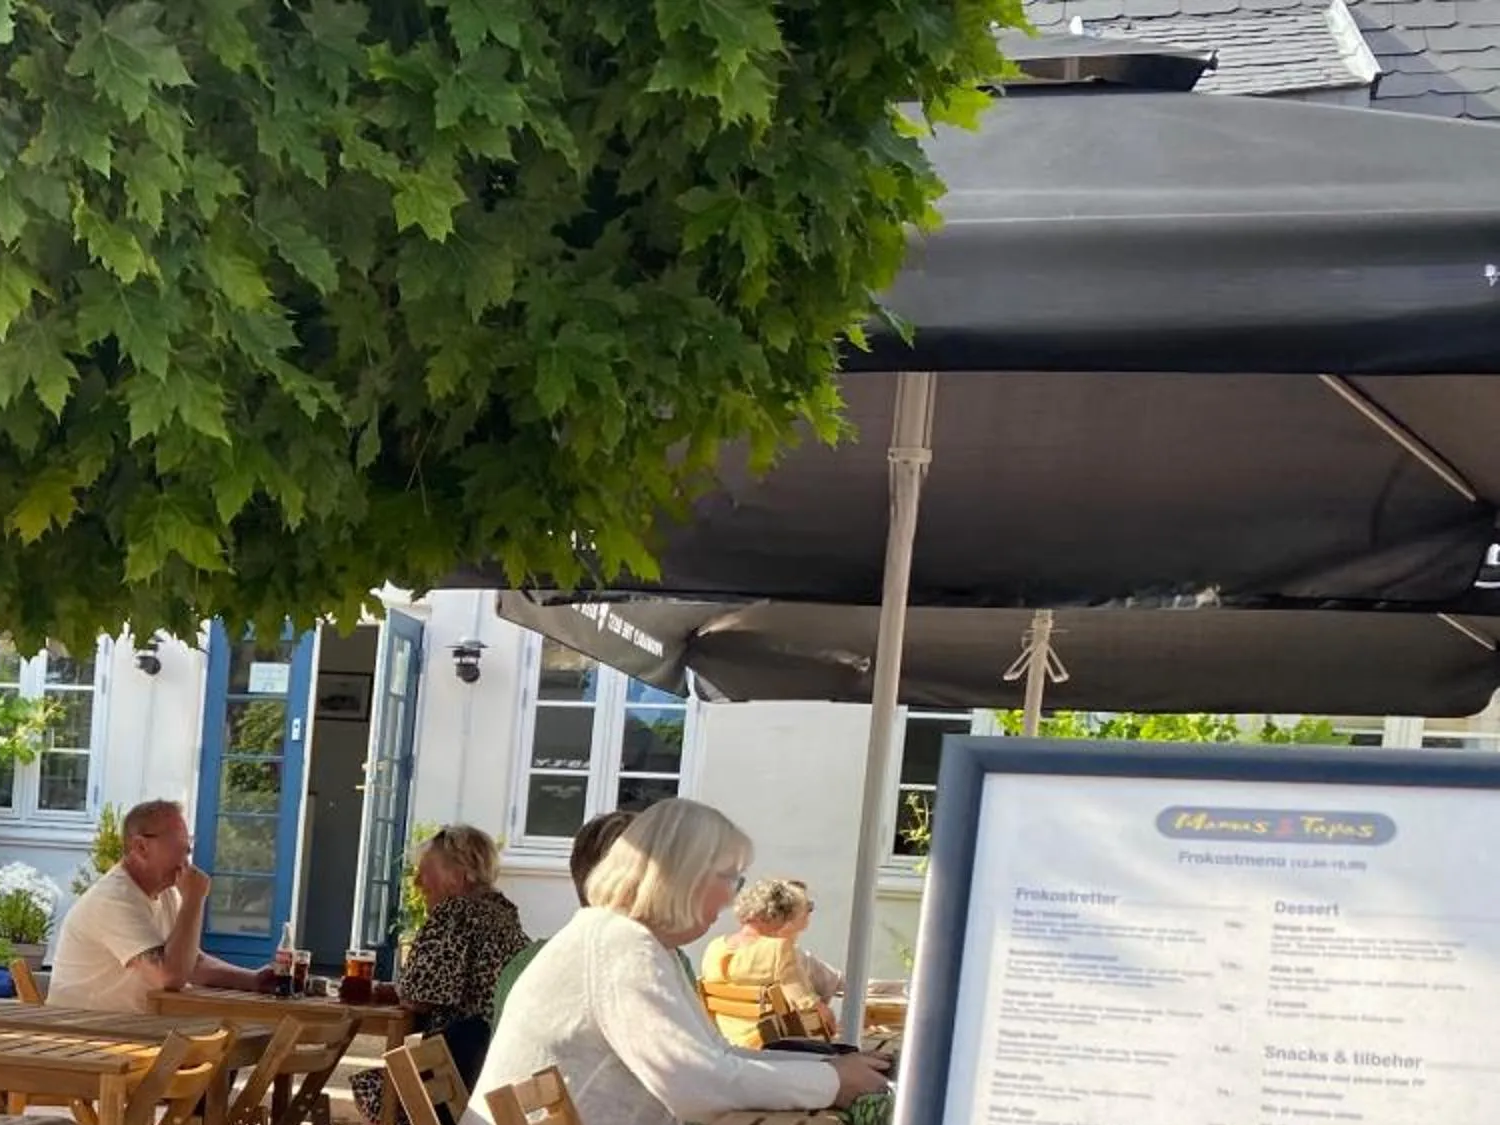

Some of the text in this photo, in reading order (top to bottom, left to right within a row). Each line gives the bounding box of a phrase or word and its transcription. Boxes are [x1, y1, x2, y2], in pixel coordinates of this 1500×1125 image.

[1178, 850, 1286, 869] Frokostmenu
[1015, 886, 1118, 905] Frokostretter
[1274, 900, 1340, 917] Dessert
[1264, 1045, 1329, 1064] Snacks
[1334, 1049, 1348, 1065] &
